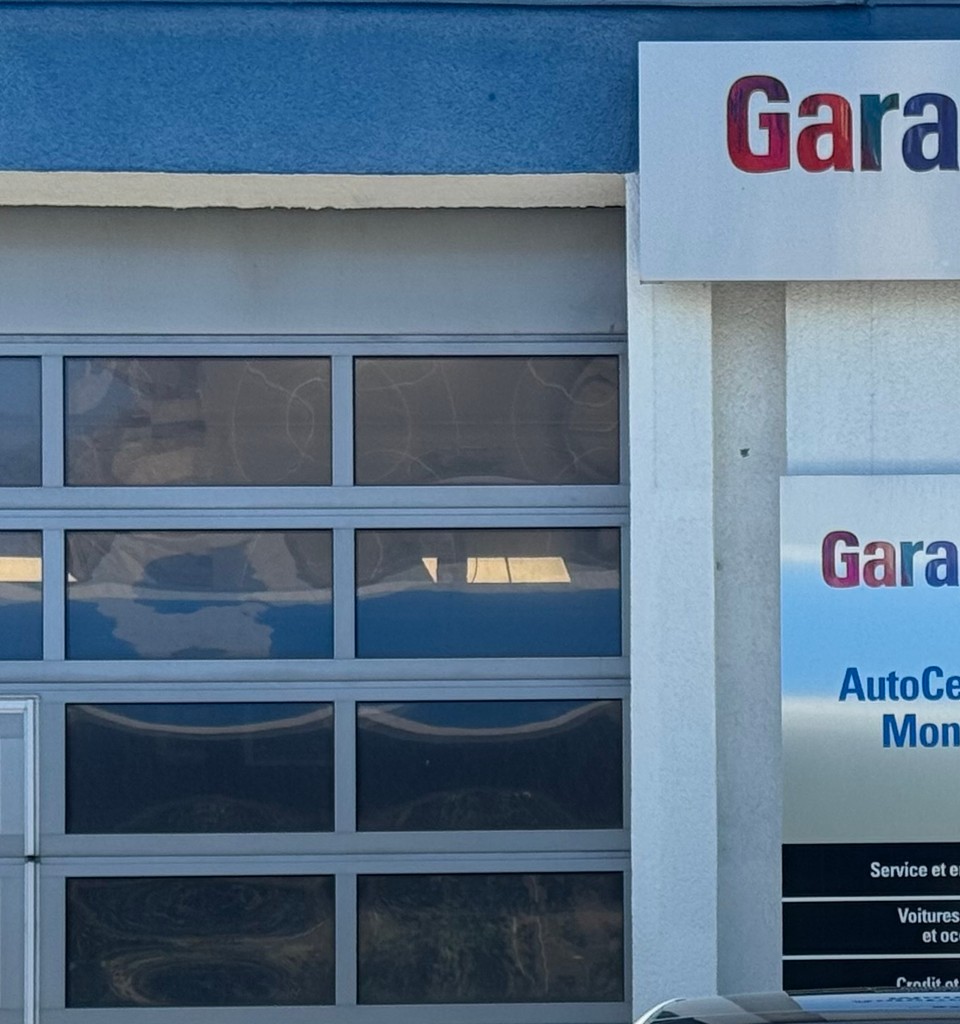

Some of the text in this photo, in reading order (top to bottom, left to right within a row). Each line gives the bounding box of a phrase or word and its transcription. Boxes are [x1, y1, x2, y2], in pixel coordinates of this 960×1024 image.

[870, 862, 928, 878] Service
[931, 862, 947, 877] et
[897, 907, 960, 924] Voitures
[922, 928, 938, 943] et
